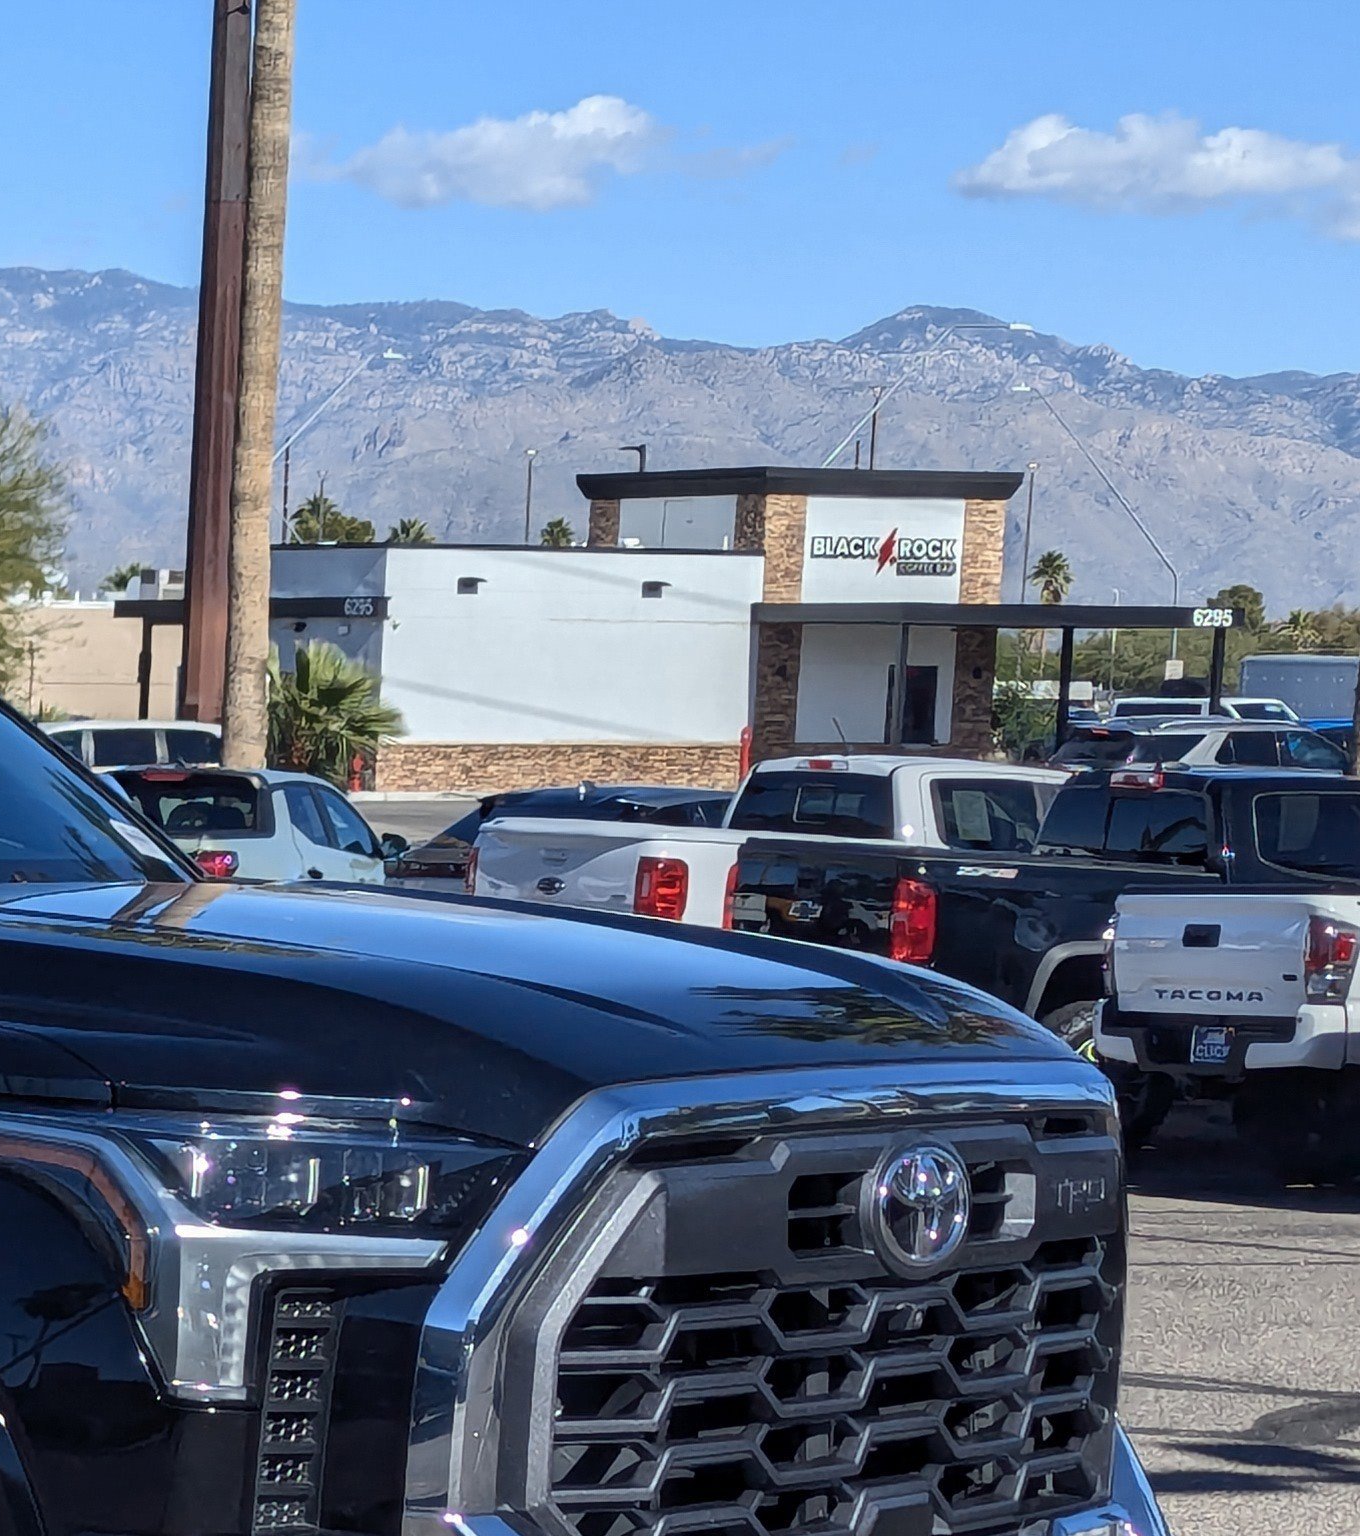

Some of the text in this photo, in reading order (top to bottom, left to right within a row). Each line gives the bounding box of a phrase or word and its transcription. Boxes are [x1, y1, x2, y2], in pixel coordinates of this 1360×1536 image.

[811, 536, 957, 561] BLACK ROCK
[1193, 608, 1233, 627] 6295
[1154, 989, 1264, 1002] TACOMA
